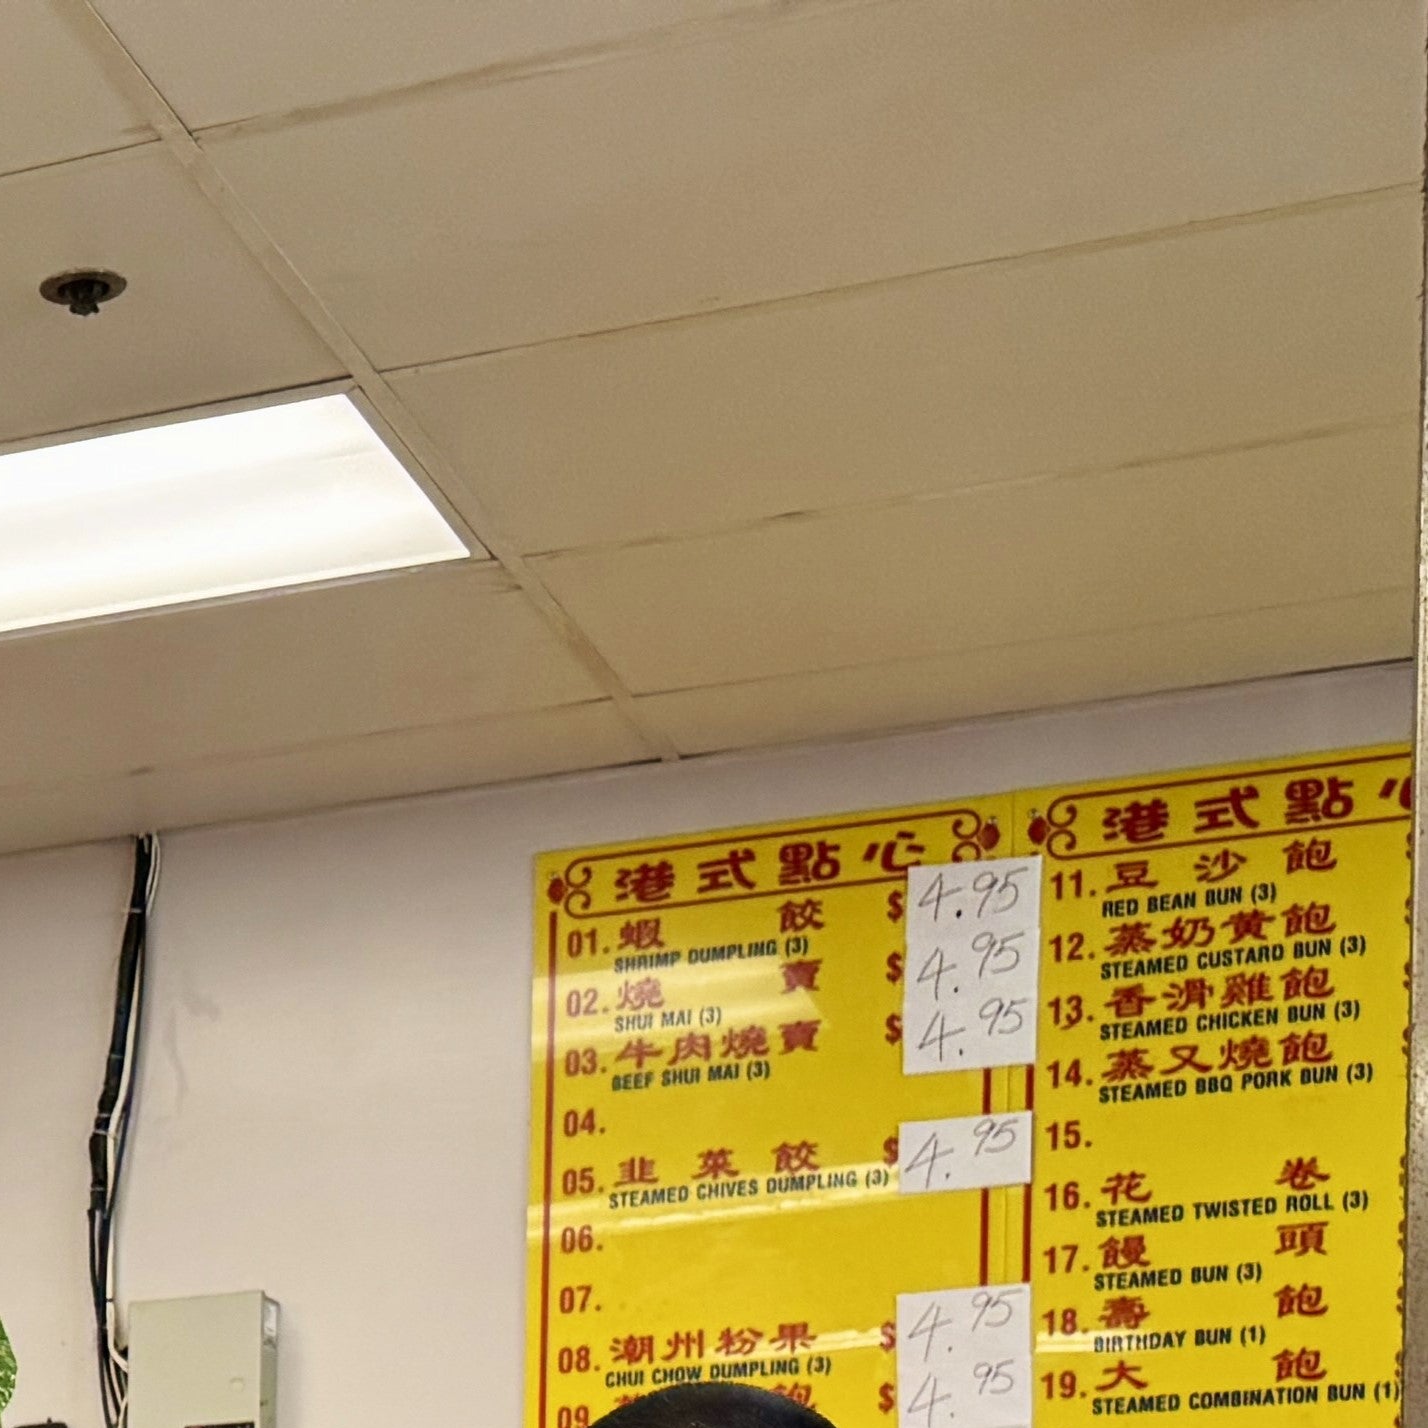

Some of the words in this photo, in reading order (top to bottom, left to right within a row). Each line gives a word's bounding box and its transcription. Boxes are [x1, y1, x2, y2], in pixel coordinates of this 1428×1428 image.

[615, 831, 926, 903] 港式點心
[1051, 870, 1096, 899] 11.
[1106, 838, 1337, 893] 豆沙飽
[918, 868, 1028, 922] 4.95
[1102, 900, 1139, 917] RED
[1146, 893, 1196, 914] BEAN
[1205, 887, 1242, 907] BUN
[1251, 882, 1277, 903] (3)
[567, 931, 609, 957] 01.
[614, 953, 681, 974] SHRIMP
[688, 939, 778, 965] DUMPLING
[785, 937, 809, 958] (3)
[1050, 933, 1095, 963] 12.
[1101, 958, 1188, 980] STEAMED
[1197, 945, 1284, 970] CUSTARD
[1293, 941, 1331, 960] BUN
[1340, 935, 1366, 958] (3)
[887, 952, 901, 983] $
[917, 931, 1024, 1000] 4.95
[566, 990, 609, 1018] 02.
[615, 1013, 654, 1032] SHUI
[661, 1009, 692, 1028] MAI
[699, 1006, 721, 1025] (3)
[1049, 996, 1093, 1030] 13.
[1100, 1019, 1187, 1041] STEAMED
[1196, 1007, 1278, 1032] CHICKEN
[1288, 1003, 1325, 1022] BUN
[1334, 1000, 1360, 1021] (3)
[885, 1014, 901, 1044] $
[918, 998, 1028, 1062] 4.95
[565, 1049, 606, 1078] 03.
[616, 1020, 821, 1070] 牛肉燒賣
[612, 1071, 654, 1092] BEEF
[661, 1067, 701, 1087] SHUI
[708, 1064, 739, 1082] MAI
[746, 1060, 770, 1080] (3)
[1047, 1059, 1092, 1088] 14.
[1099, 1082, 1187, 1104] STEAMED
[1195, 1074, 1232, 1095] BBQ
[1241, 1067, 1291, 1091] PORK
[1300, 1064, 1337, 1084] BUN
[1347, 1062, 1373, 1083] (3)
[564, 1109, 606, 1137] 04.
[1046, 1121, 1092, 1150] 15.
[905, 1118, 1019, 1188] 4.95
[563, 1168, 604, 1196] 05.
[609, 1186, 689, 1210] STEAMED
[697, 1179, 759, 1201] CHIVES
[766, 1171, 857, 1196] DUMPLING
[865, 1169, 889, 1189] (3)
[1044, 1181, 1091, 1212] 16.
[1096, 1204, 1183, 1228] STEAMED
[1193, 1196, 1277, 1221] TWISTED
[1286, 1194, 1334, 1213] ROLL
[1343, 1190, 1368, 1212] (3)
[561, 1226, 603, 1253] 06.
[1043, 1245, 1089, 1274] 17.
[1094, 1268, 1181, 1291] STEAMED
[1191, 1265, 1228, 1284] BUN
[1236, 1262, 1261, 1284] (3)
[560, 1285, 602, 1313] 07.
[908, 1289, 1022, 1362] 4.95
[1043, 1309, 1089, 1336] 18.
[1093, 1329, 1186, 1353] BIRTHDAY
[1194, 1327, 1231, 1347] BUN
[1240, 1325, 1265, 1346] (1)
[558, 1346, 601, 1374] 08.
[610, 1322, 818, 1366] 潮州粉果
[605, 1368, 644, 1389] CHUI
[652, 1364, 701, 1385] CHOW
[709, 1357, 800, 1382] DUMPLING
[807, 1355, 832, 1376] (3)
[1041, 1371, 1086, 1399] 19.
[908, 1360, 1014, 1428] 4.95
[1092, 1393, 1180, 1416] STEAMED
[1189, 1386, 1318, 1409] COMBINATION
[1327, 1383, 1365, 1402] BUN
[1374, 1381, 1400, 1403] (1)
